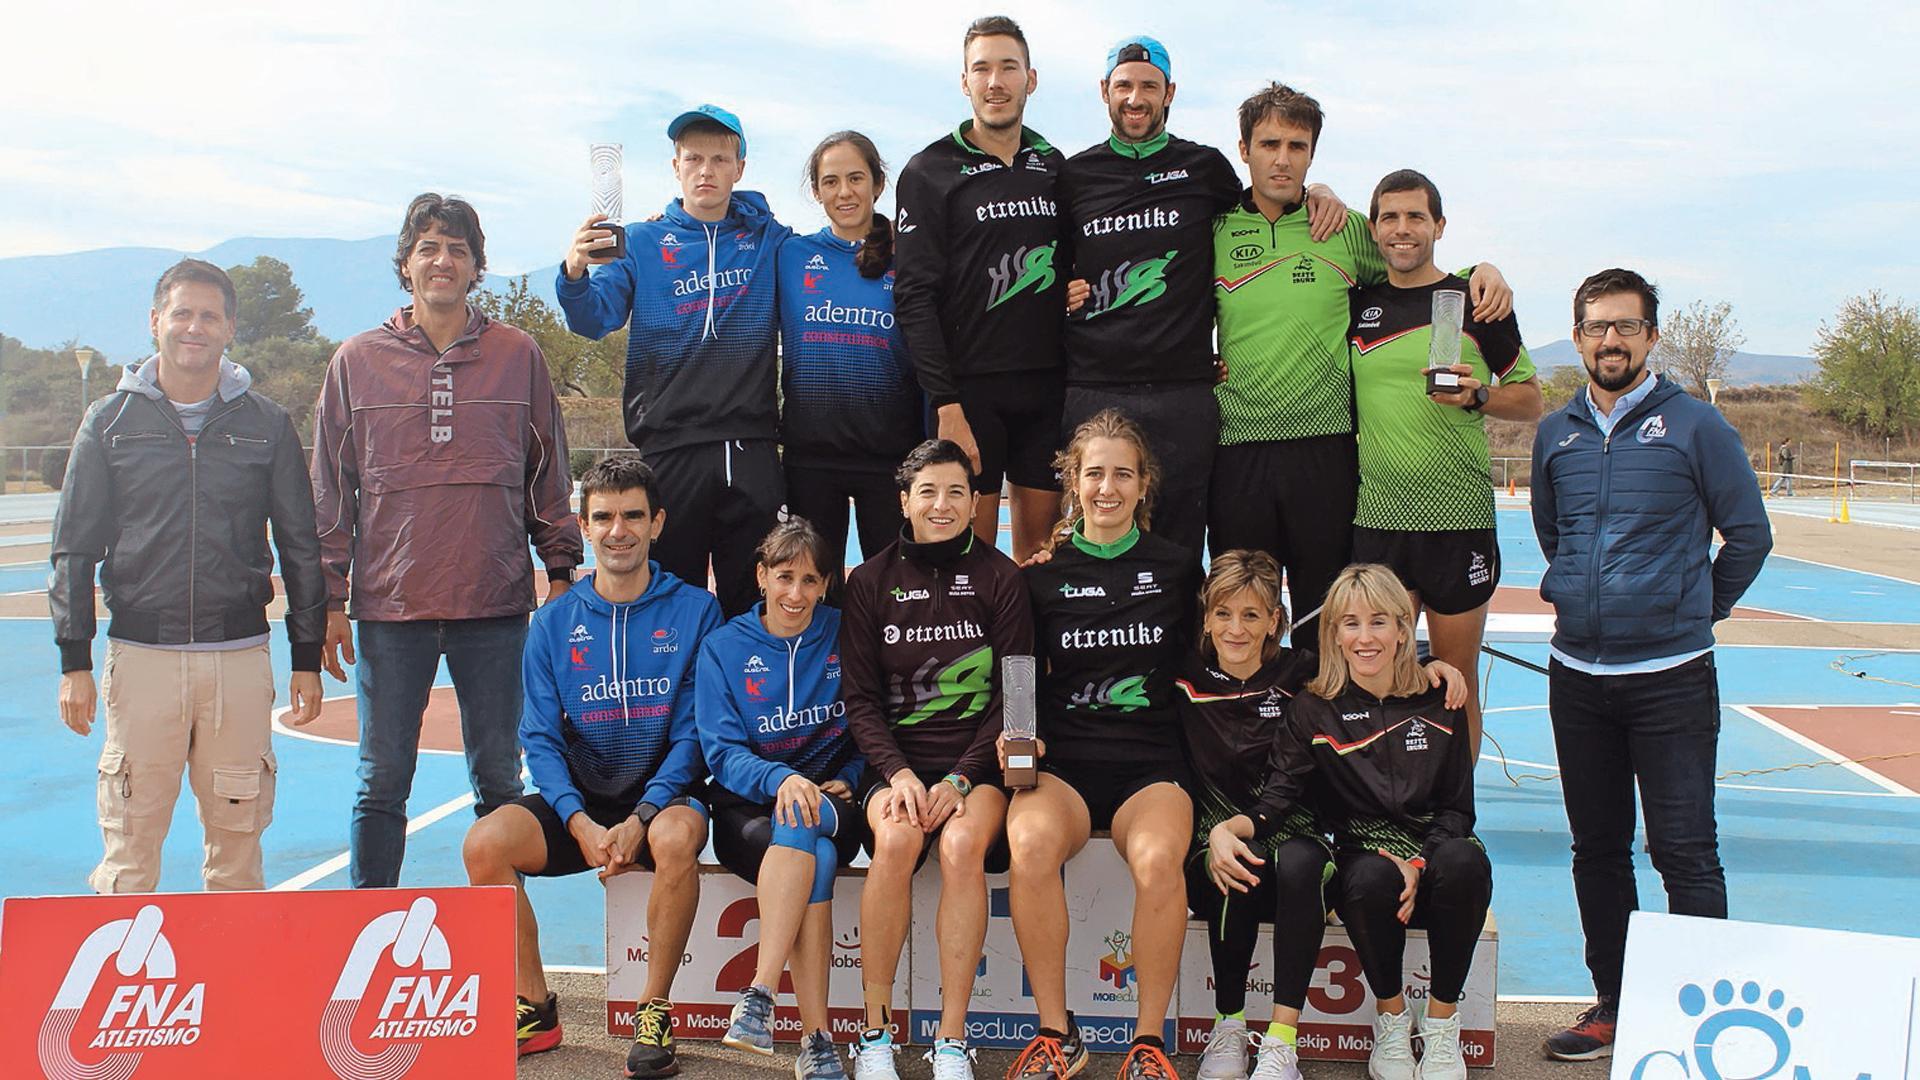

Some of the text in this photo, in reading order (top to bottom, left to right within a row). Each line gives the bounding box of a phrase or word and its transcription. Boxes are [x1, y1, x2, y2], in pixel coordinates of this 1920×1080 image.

[805, 299, 895, 329] adentro
[1061, 622, 1163, 649] etxenike
[581, 675, 671, 702] adentro
[757, 701, 846, 733] adentro
[1306, 945, 1366, 1015] 3
[98, 983, 205, 1029] FNA
[377, 974, 480, 1020] FNA
[88, 1026, 201, 1049] ATLETISMO
[368, 1018, 477, 1039] ATLETISMO
